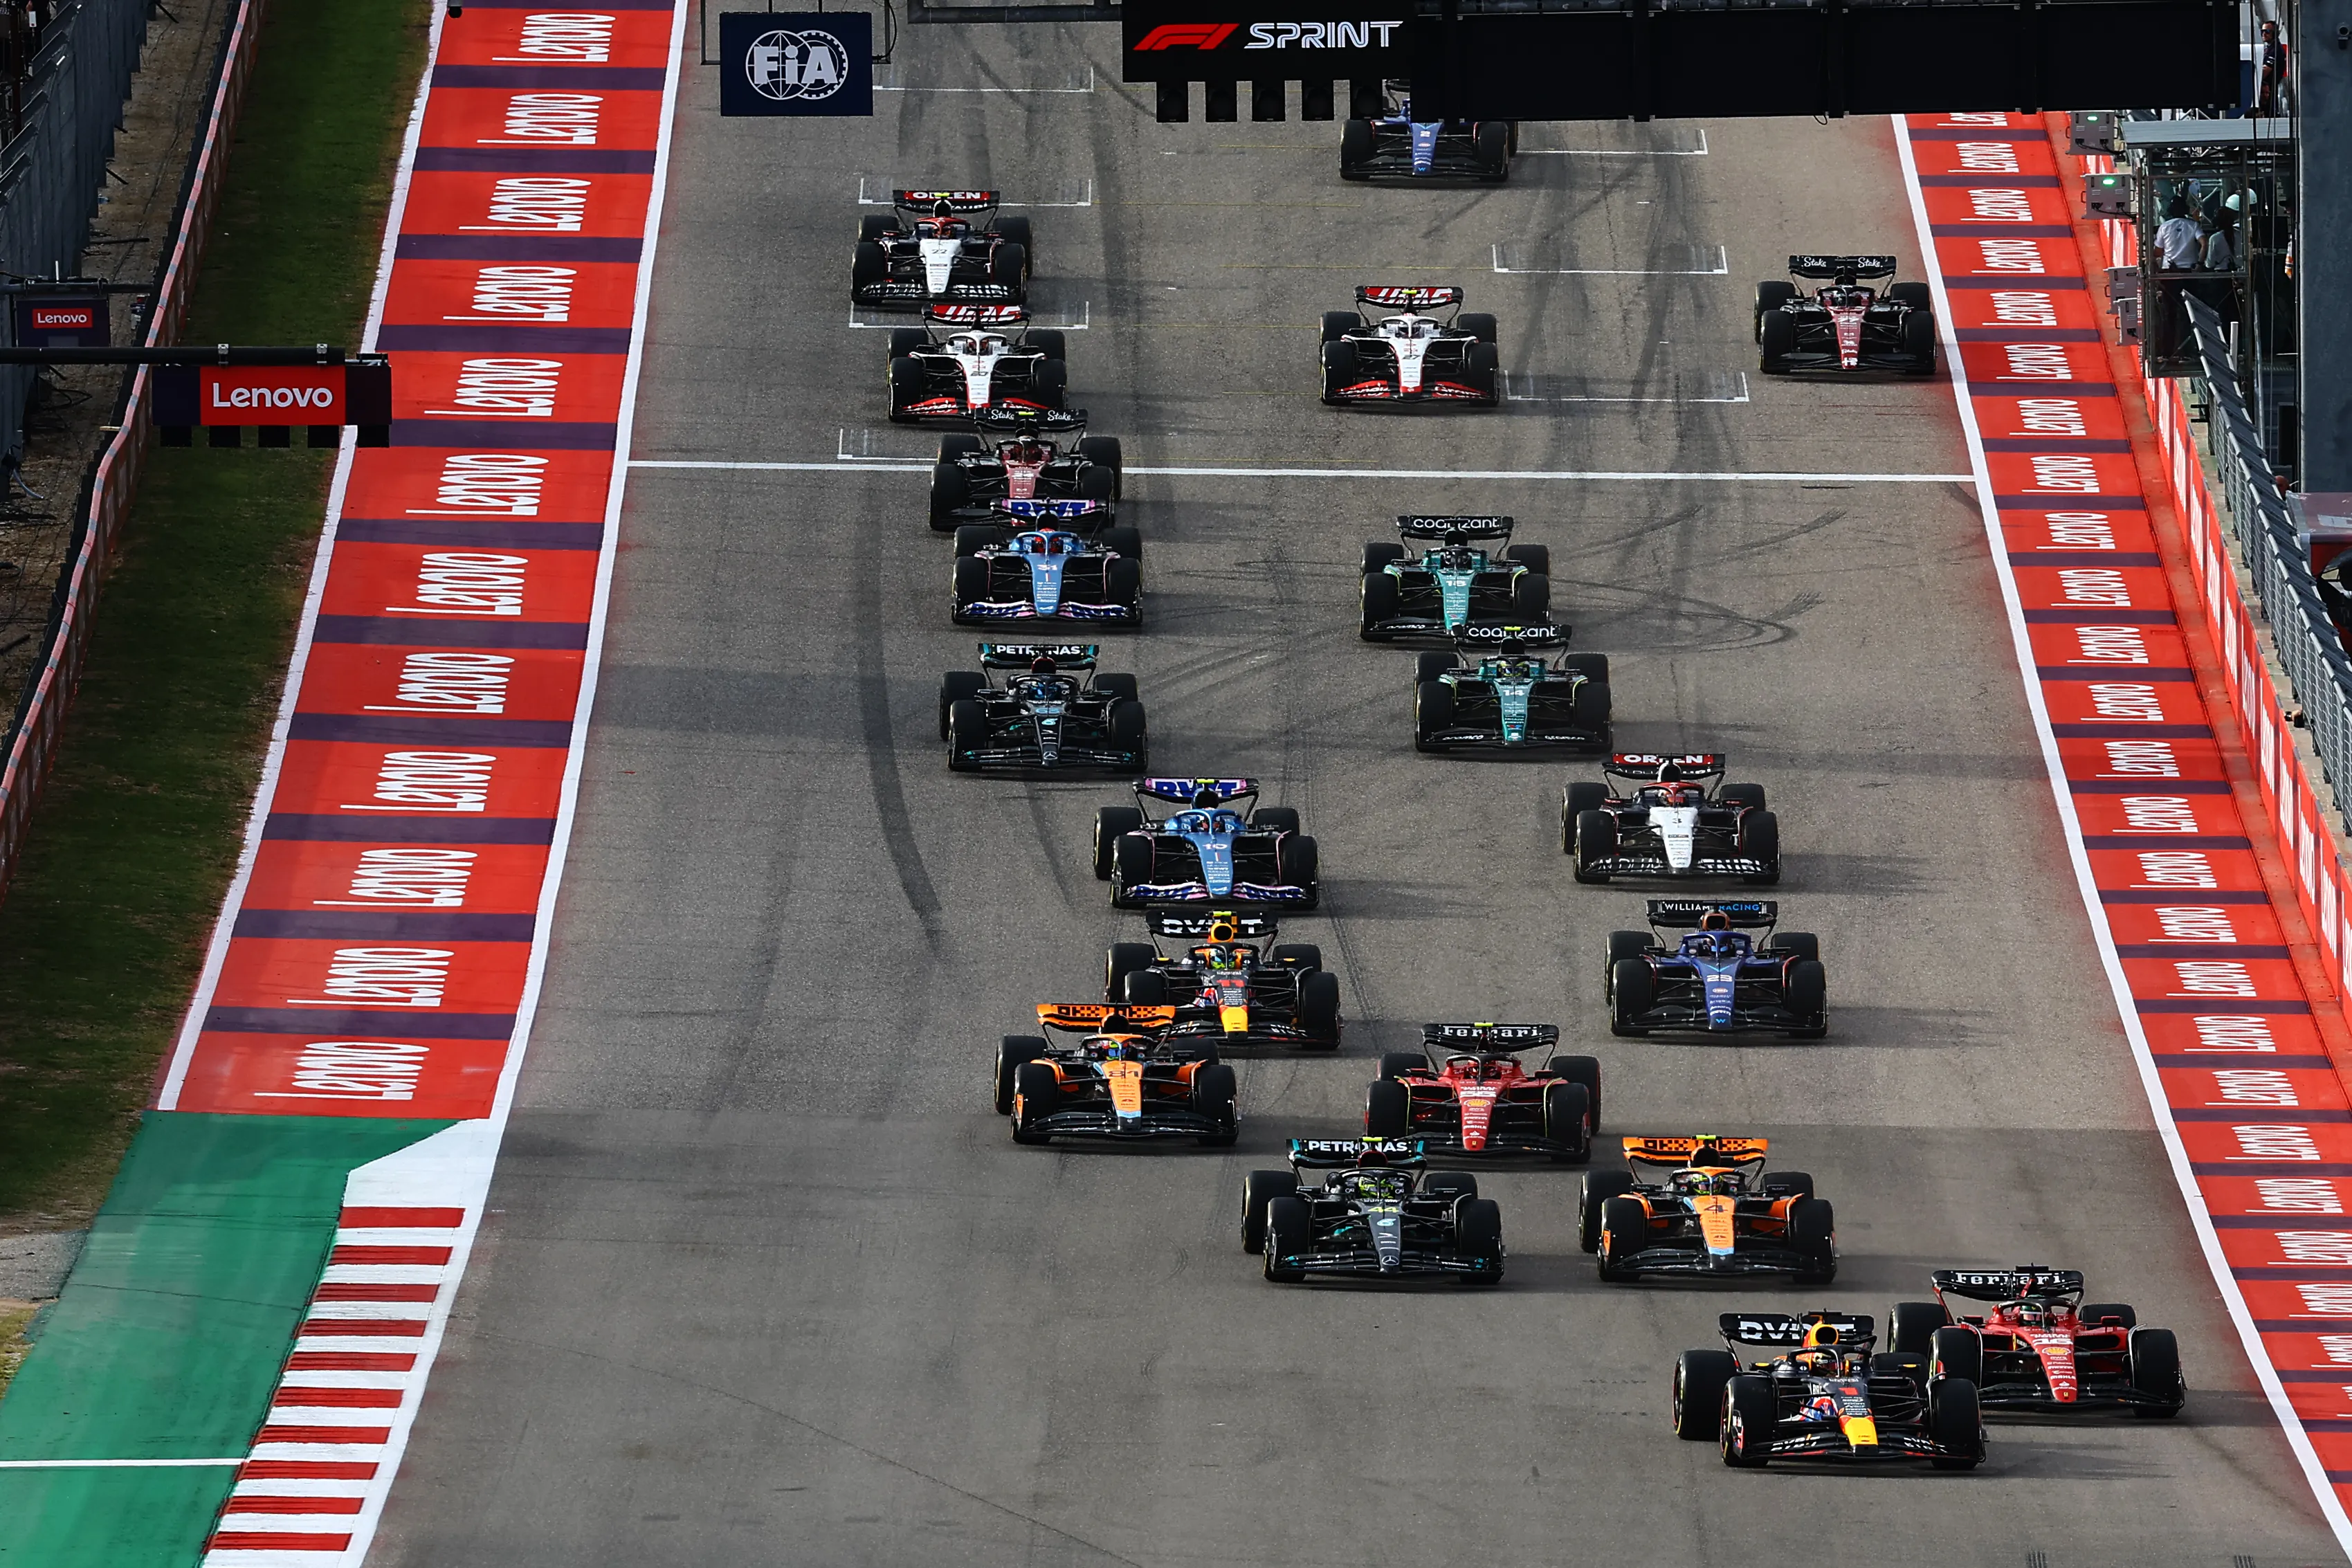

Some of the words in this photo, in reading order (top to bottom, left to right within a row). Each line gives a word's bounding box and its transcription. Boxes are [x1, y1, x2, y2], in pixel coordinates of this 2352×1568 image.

[492, 14, 615, 62] Lenovo
[1244, 21, 1403, 48] SPRINT
[477, 94, 603, 144] Lenovo
[1948, 143, 2018, 172] Lenovo
[459, 179, 591, 230] Lenovo
[1961, 189, 2032, 221] Lenovo
[1804, 257, 1827, 267] Stake
[1858, 257, 1880, 268] Stake
[1971, 240, 2045, 273] Lenovo
[444, 267, 576, 321] Lenovo
[1982, 292, 2057, 325] Lenovo
[37, 312, 87, 324] Lenovo
[1996, 345, 2071, 379] Lenovo
[212, 383, 332, 408] Lenovo
[424, 359, 563, 416] Lenovo
[992, 409, 1014, 420] Stake
[1048, 410, 1071, 421] Stake
[2009, 399, 2086, 435] Lenovo
[406, 455, 549, 515] Lenovo
[2022, 456, 2099, 493] Lenovo
[2036, 513, 2115, 549] Lenovo
[386, 554, 528, 614] Lenovo
[2051, 569, 2131, 606] Lenovo
[997, 645, 1080, 655] PETRNAS
[2067, 627, 2149, 664] Lenovo
[364, 653, 514, 713] Lenovo
[2081, 684, 2164, 720] Lenovo
[1623, 755, 1703, 763] OREN
[2096, 741, 2180, 776] Lenovo
[340, 752, 496, 811] Lenovo
[2113, 797, 2198, 832] Lenovo
[313, 849, 477, 906] Lenovo
[2130, 853, 2216, 888] Lenovo
[2148, 907, 2236, 942] Lenovo
[287, 948, 454, 1006] Lenovo
[1216, 979, 1244, 987] 11
[2167, 962, 2257, 996] Lenovo
[2185, 1017, 2276, 1052] Lenovo
[254, 1042, 429, 1100] Lenovo
[2205, 1070, 2299, 1106] Lenovo
[2225, 1125, 2320, 1160] Lenovo
[1704, 1205, 1729, 1213] 4
[2245, 1179, 2343, 1213] Lenovo
[1740, 1321, 1854, 1340] BYBT
[1838, 1387, 1859, 1396] 1
